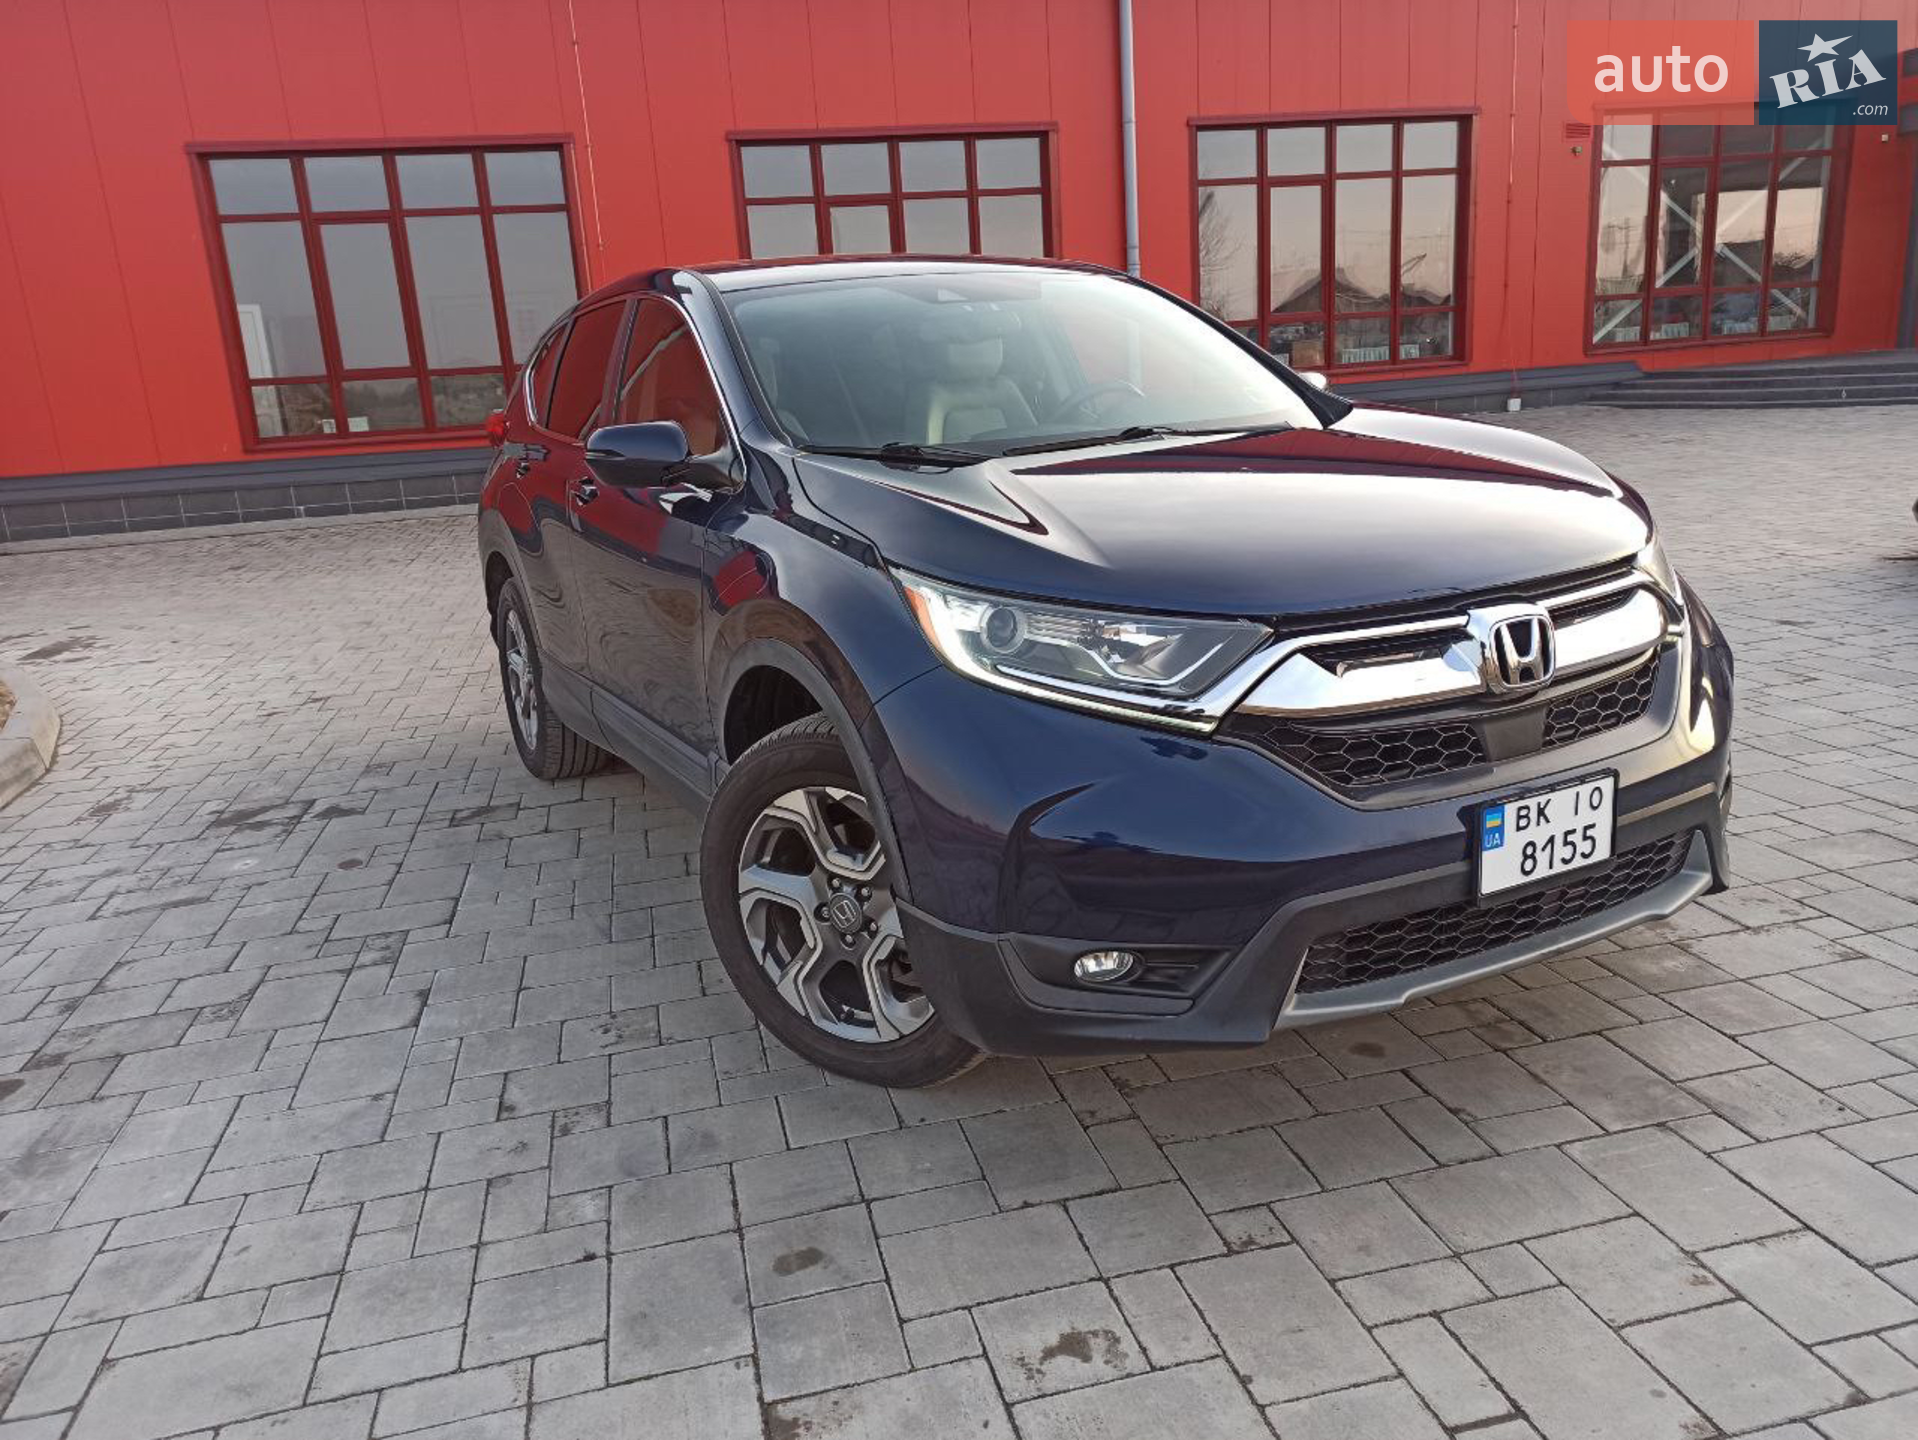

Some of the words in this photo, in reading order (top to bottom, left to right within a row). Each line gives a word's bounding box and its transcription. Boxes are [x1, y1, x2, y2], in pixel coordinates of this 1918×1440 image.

[1515, 798, 1552, 832] BK
[1485, 832, 1501, 848] UA
[1520, 822, 1597, 876] 8155
